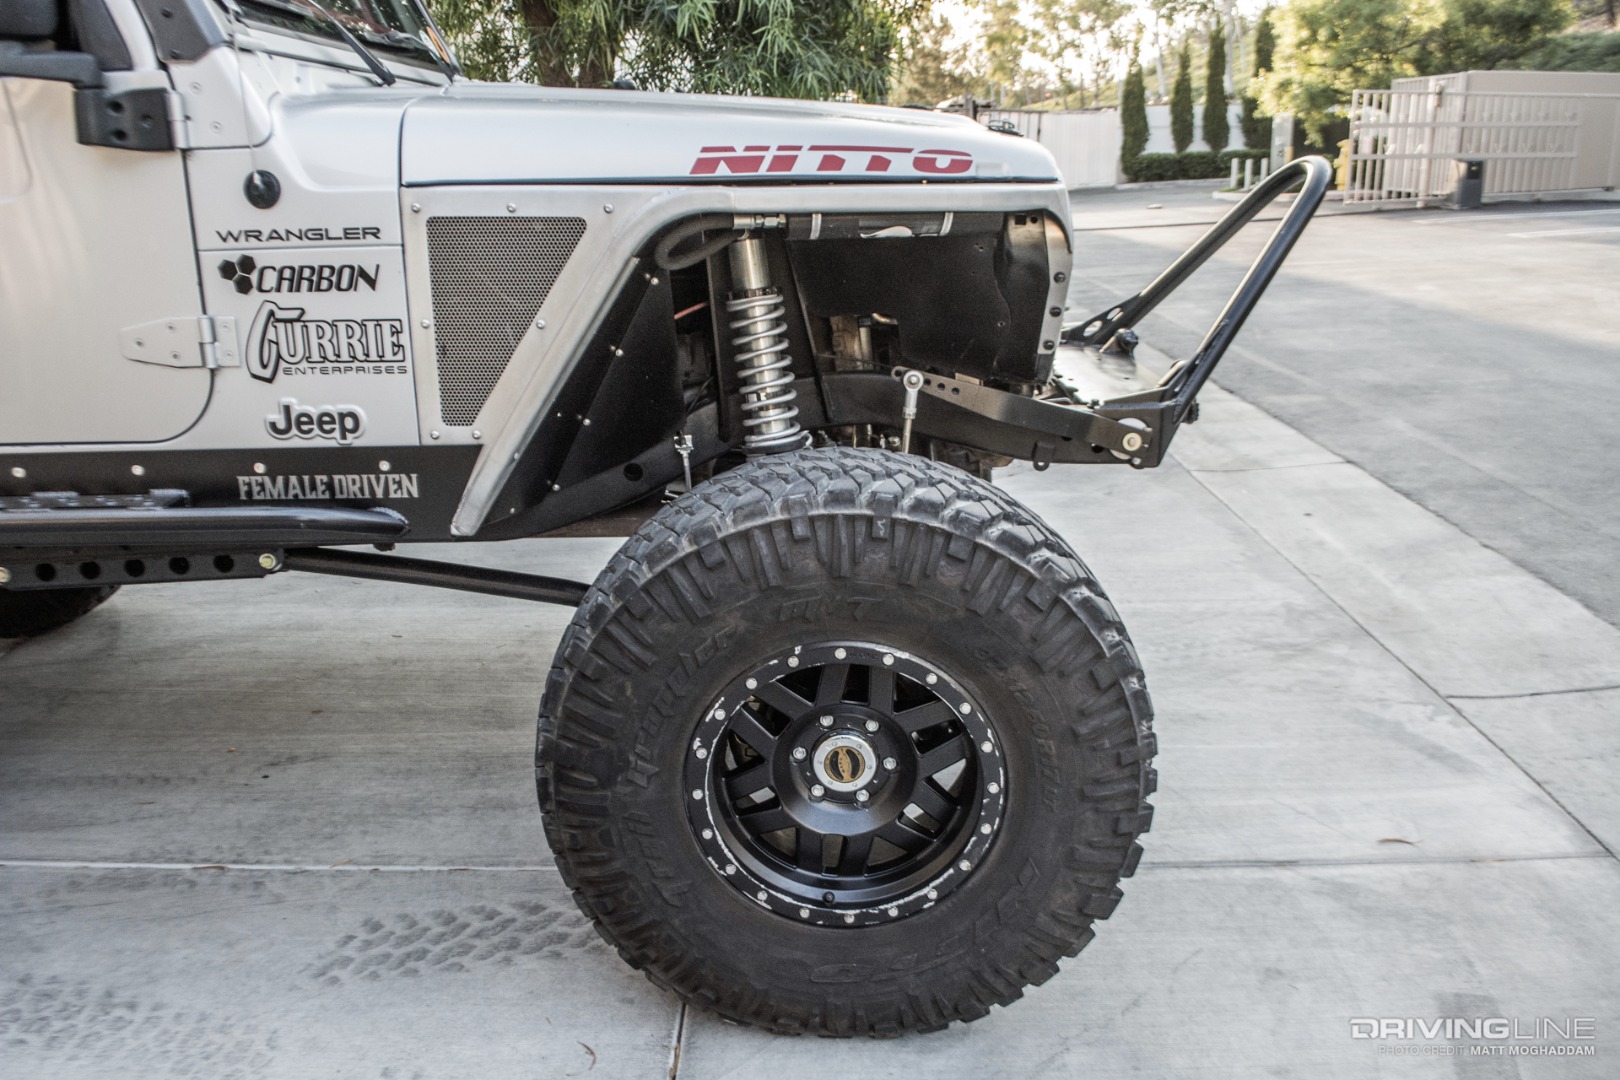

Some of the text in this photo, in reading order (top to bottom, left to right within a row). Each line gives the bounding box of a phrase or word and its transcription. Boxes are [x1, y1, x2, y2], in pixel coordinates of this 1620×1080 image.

[689, 145, 974, 174] NITTO
[216, 227, 381, 243] WRANGLER
[255, 263, 380, 293] CARBON
[245, 300, 405, 384] CURRIE
[282, 366, 408, 376] ENTERPRISES
[268, 403, 361, 441] Jeep
[236, 473, 419, 500] FEMALE DRIVEN
